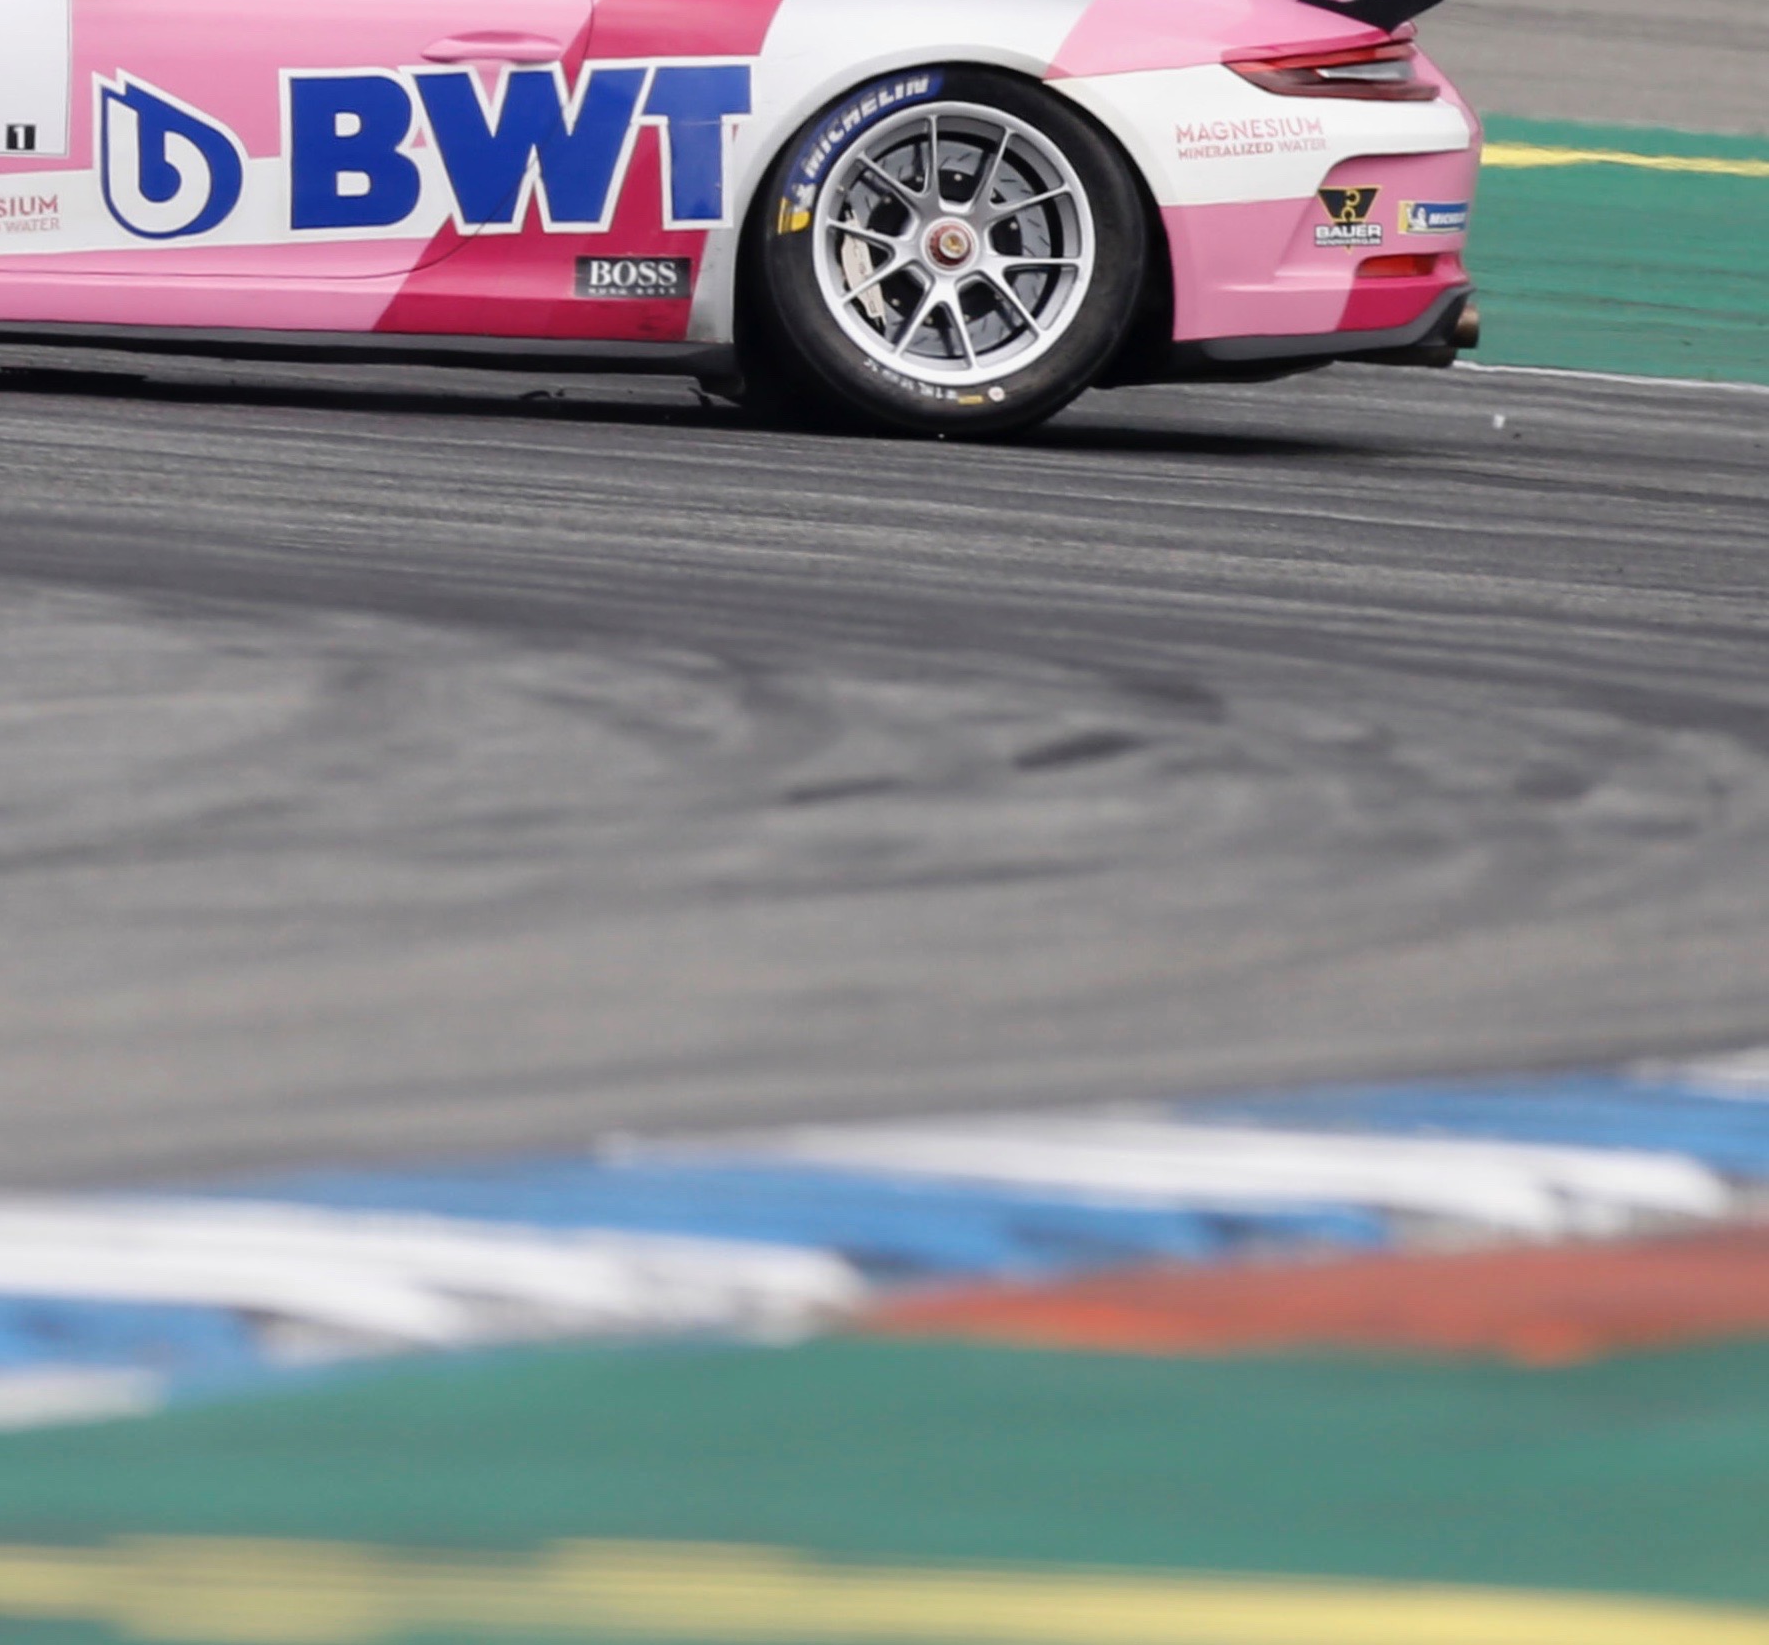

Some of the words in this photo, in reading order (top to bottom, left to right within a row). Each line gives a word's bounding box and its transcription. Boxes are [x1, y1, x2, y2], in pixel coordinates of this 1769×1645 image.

[6, 124, 37, 151] 1
[799, 72, 931, 179] MICHELIN
[1174, 116, 1324, 144] MAGNESIUM
[283, 61, 754, 233] BWT
[1178, 142, 1274, 161] MINERALIZED
[1278, 138, 1328, 153] WATER
[3, 217, 61, 234] WATER
[1315, 223, 1383, 239] BAUER
[589, 259, 678, 287] BOSS
